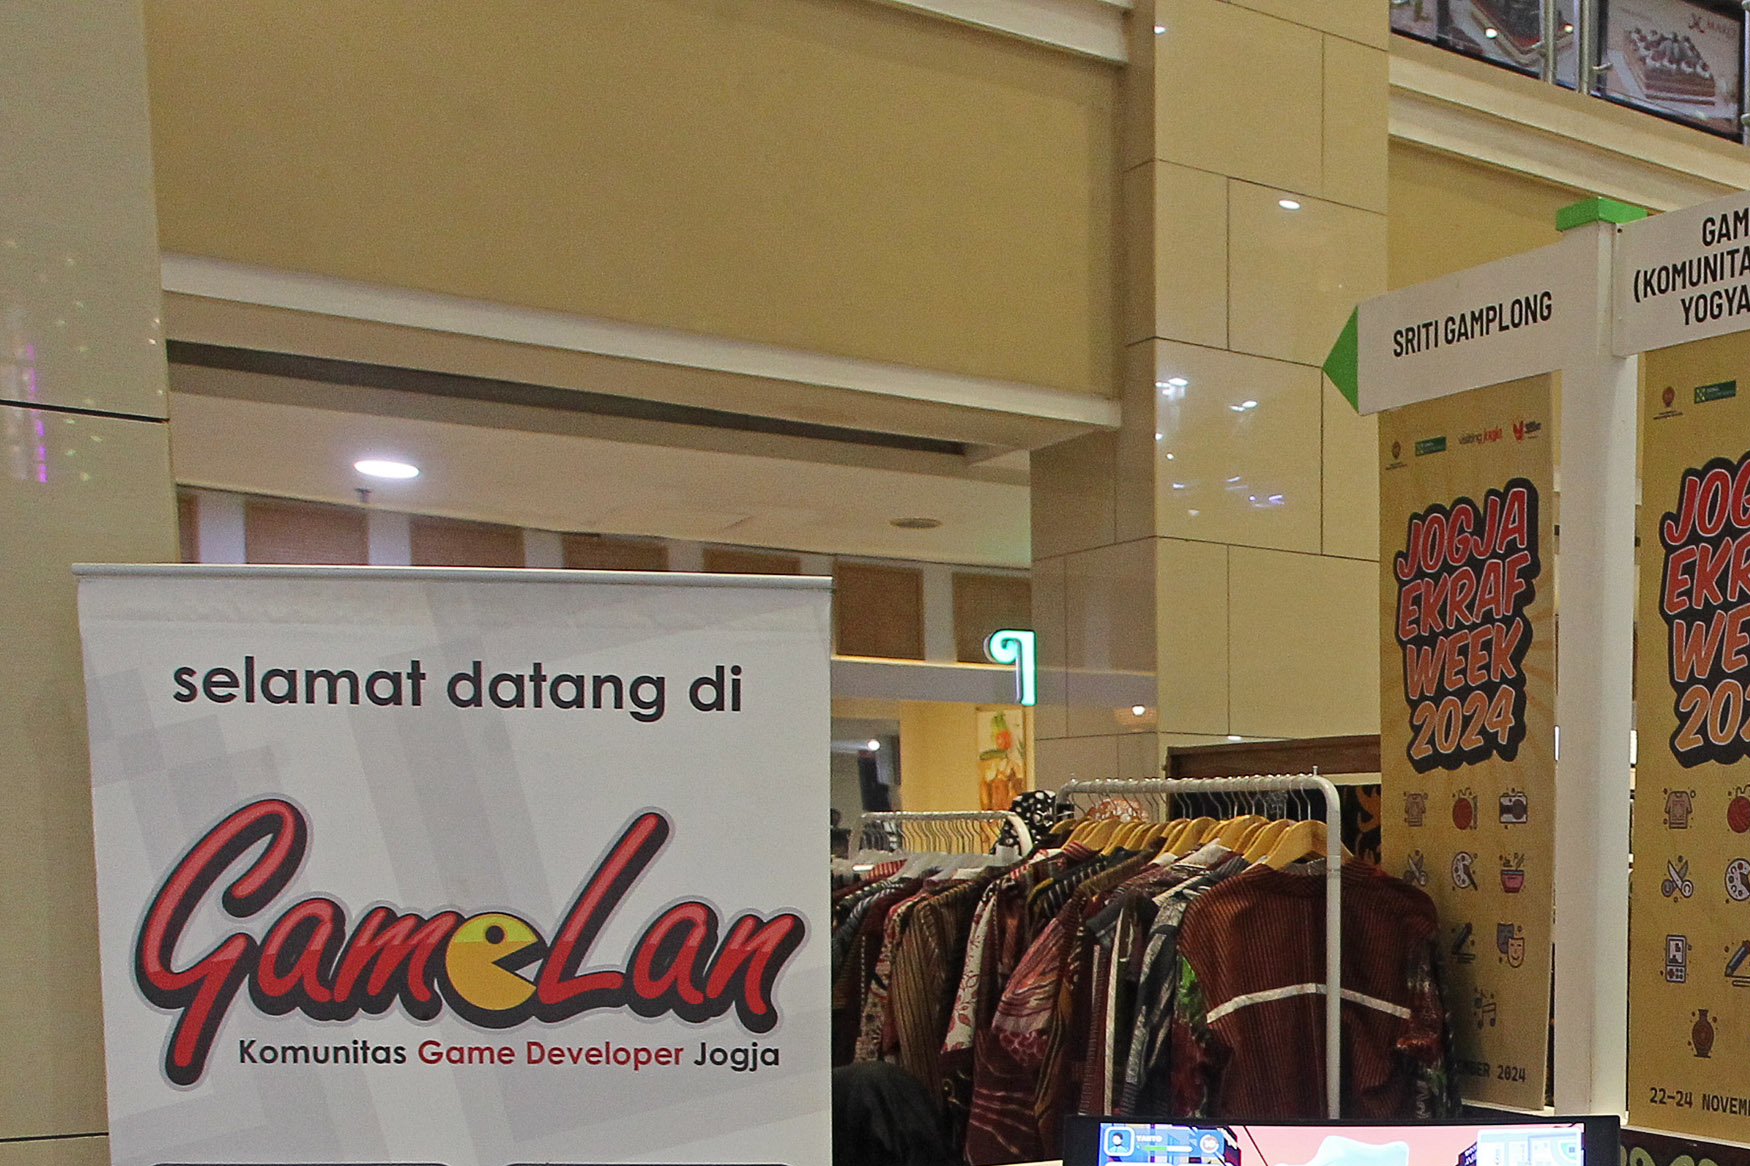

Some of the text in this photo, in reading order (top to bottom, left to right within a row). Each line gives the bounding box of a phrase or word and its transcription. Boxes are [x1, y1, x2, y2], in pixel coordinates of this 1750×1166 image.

[1392, 291, 1553, 358] SRITI GAMPLONG
[1397, 487, 1529, 580] JOGJA
[1399, 551, 1532, 641] EKRAF
[172, 656, 744, 722] selamat datang di
[1406, 617, 1523, 701] WEEK
[1410, 684, 1516, 759] 2024
[135, 798, 806, 1087] GameLan
[238, 1038, 780, 1073] Komunitas Game Developer Jogja
[1497, 1064, 1526, 1082] 2024
[1649, 1086, 1693, 1109] 22-24
